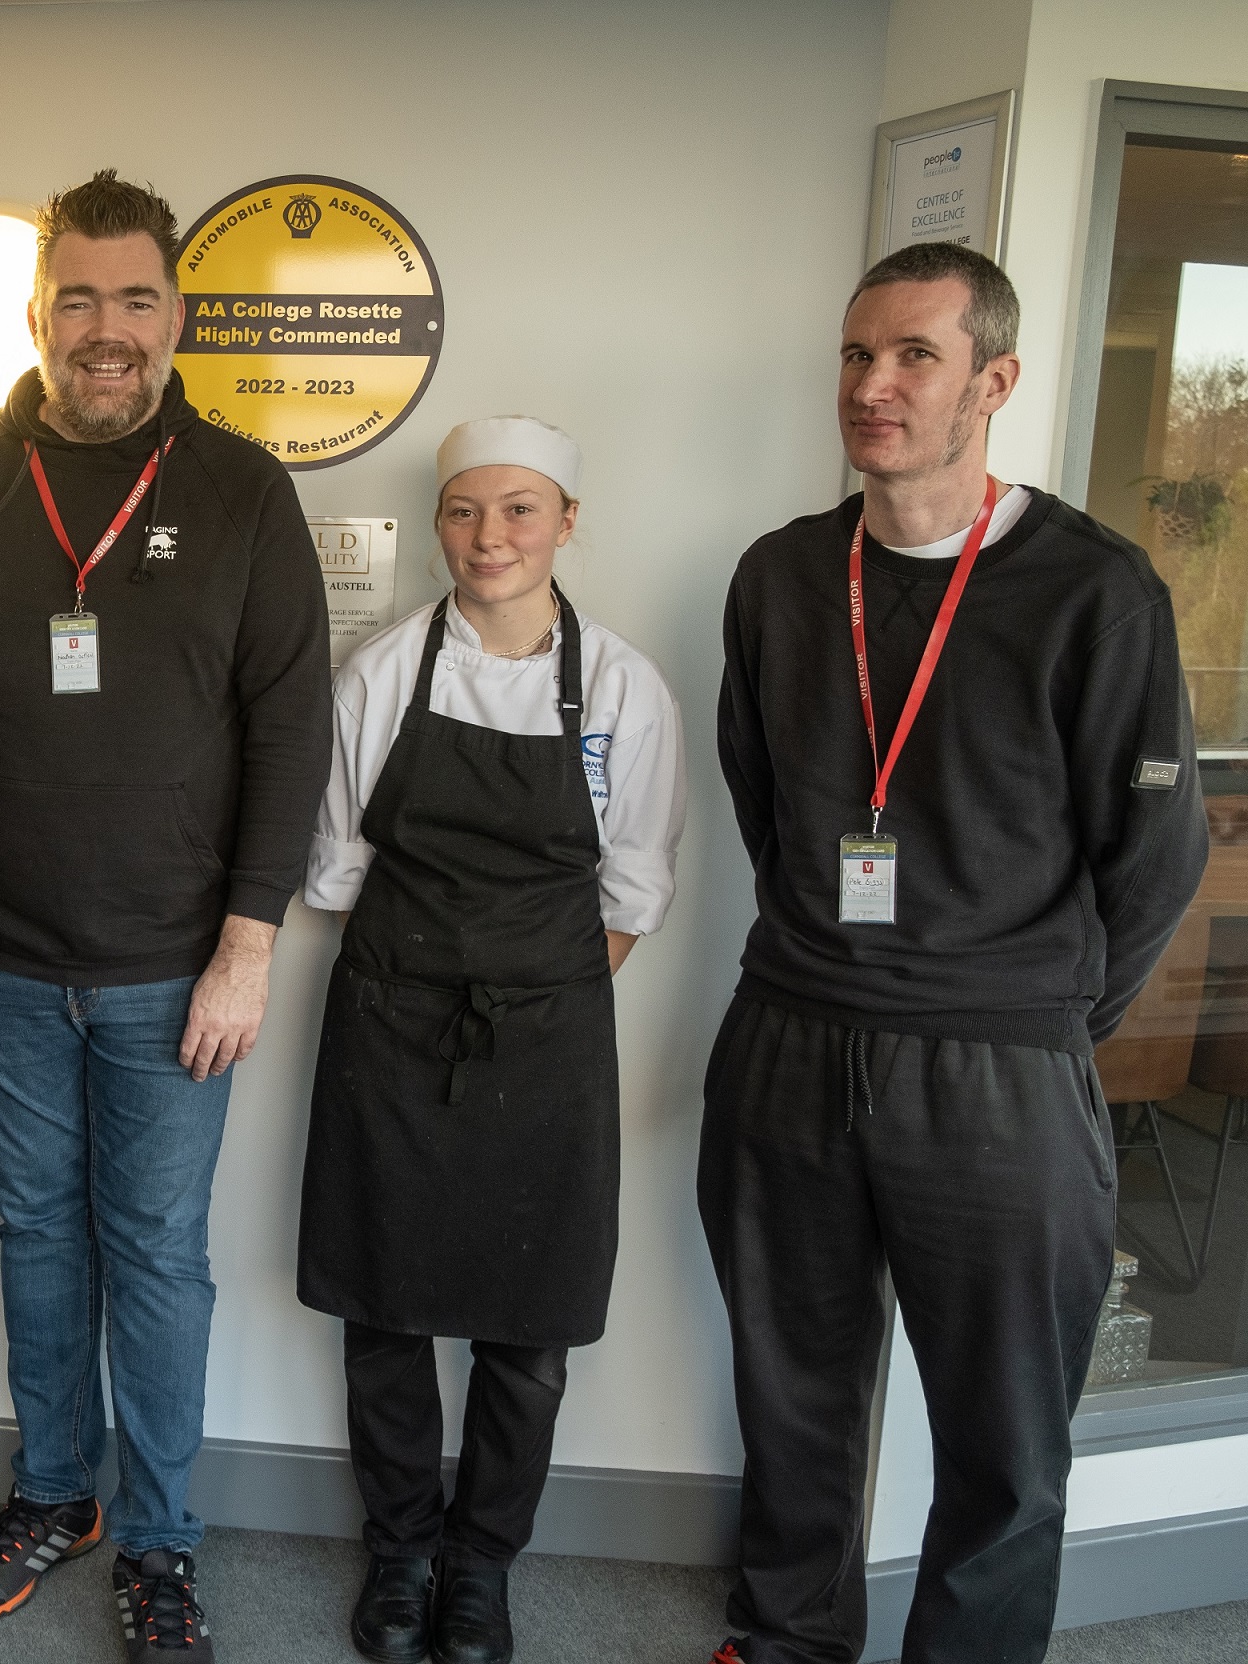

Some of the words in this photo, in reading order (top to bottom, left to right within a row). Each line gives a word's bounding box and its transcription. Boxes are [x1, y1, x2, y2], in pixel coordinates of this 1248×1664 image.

[924, 150, 952, 170] people
[916, 192, 950, 210] CENTRE
[952, 189, 964, 202] OF
[912, 206, 966, 228] EXCELLENCE
[188, 198, 273, 272] AUTOMOBILE
[328, 198, 416, 273] ASSOCIATION
[196, 302, 226, 318] AA
[232, 302, 312, 322] College
[320, 302, 402, 319] Rosette
[196, 326, 262, 346] Highly
[268, 328, 401, 344] Commended
[236, 378, 286, 394] 2022
[304, 380, 354, 395] 2023
[287, 410, 384, 454] Restaurant
[124, 480, 148, 513] VISITOR
[90, 530, 117, 564] VISITOR
[318, 554, 359, 565] ALITY
[330, 582, 374, 591] AUSTELL
[851, 579, 861, 626] VISITOR
[857, 653, 868, 700] VISITOR
[865, 863, 872, 872] V
